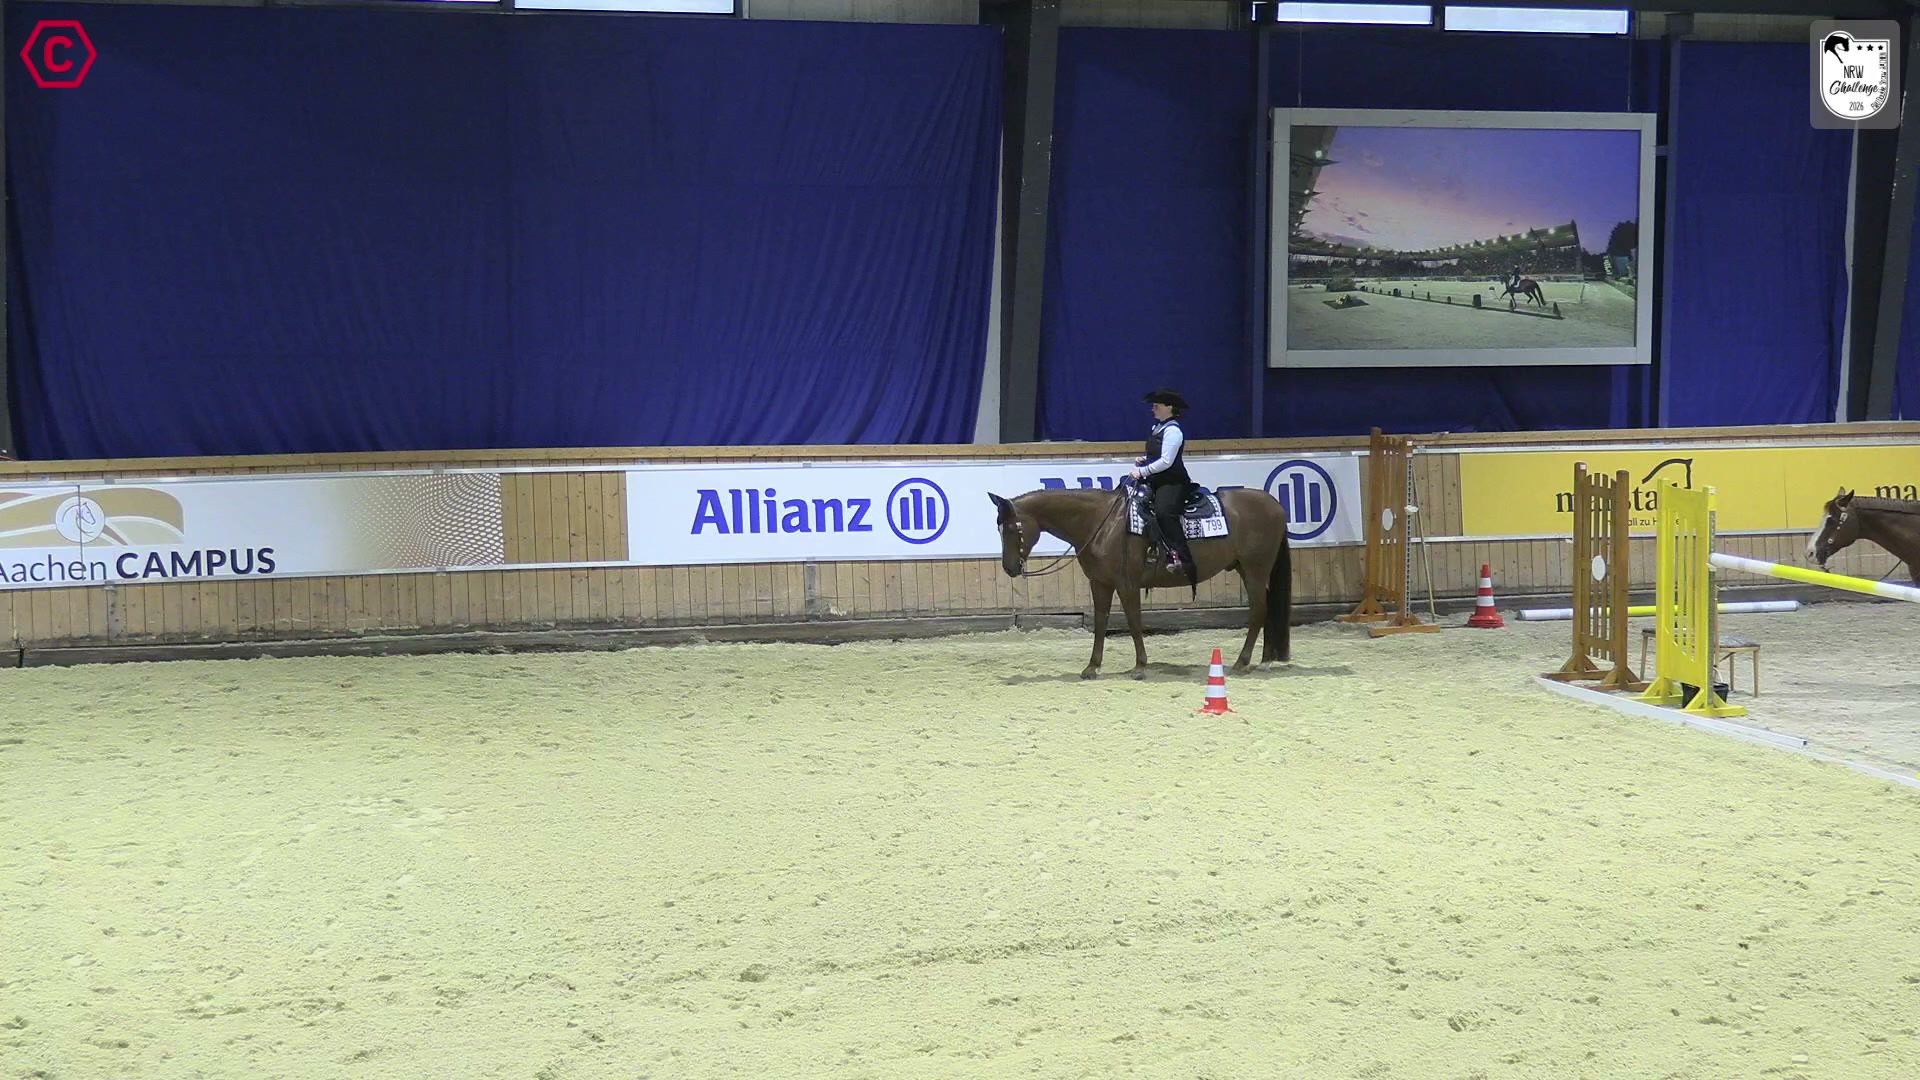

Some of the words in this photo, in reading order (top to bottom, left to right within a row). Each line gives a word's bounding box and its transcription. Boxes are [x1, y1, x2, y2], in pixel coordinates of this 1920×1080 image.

[690, 487, 873, 535] Allianz
[1639, 518, 1650, 526] zu
[1204, 518, 1223, 532] 799
[115, 547, 276, 580] CAMPUS
